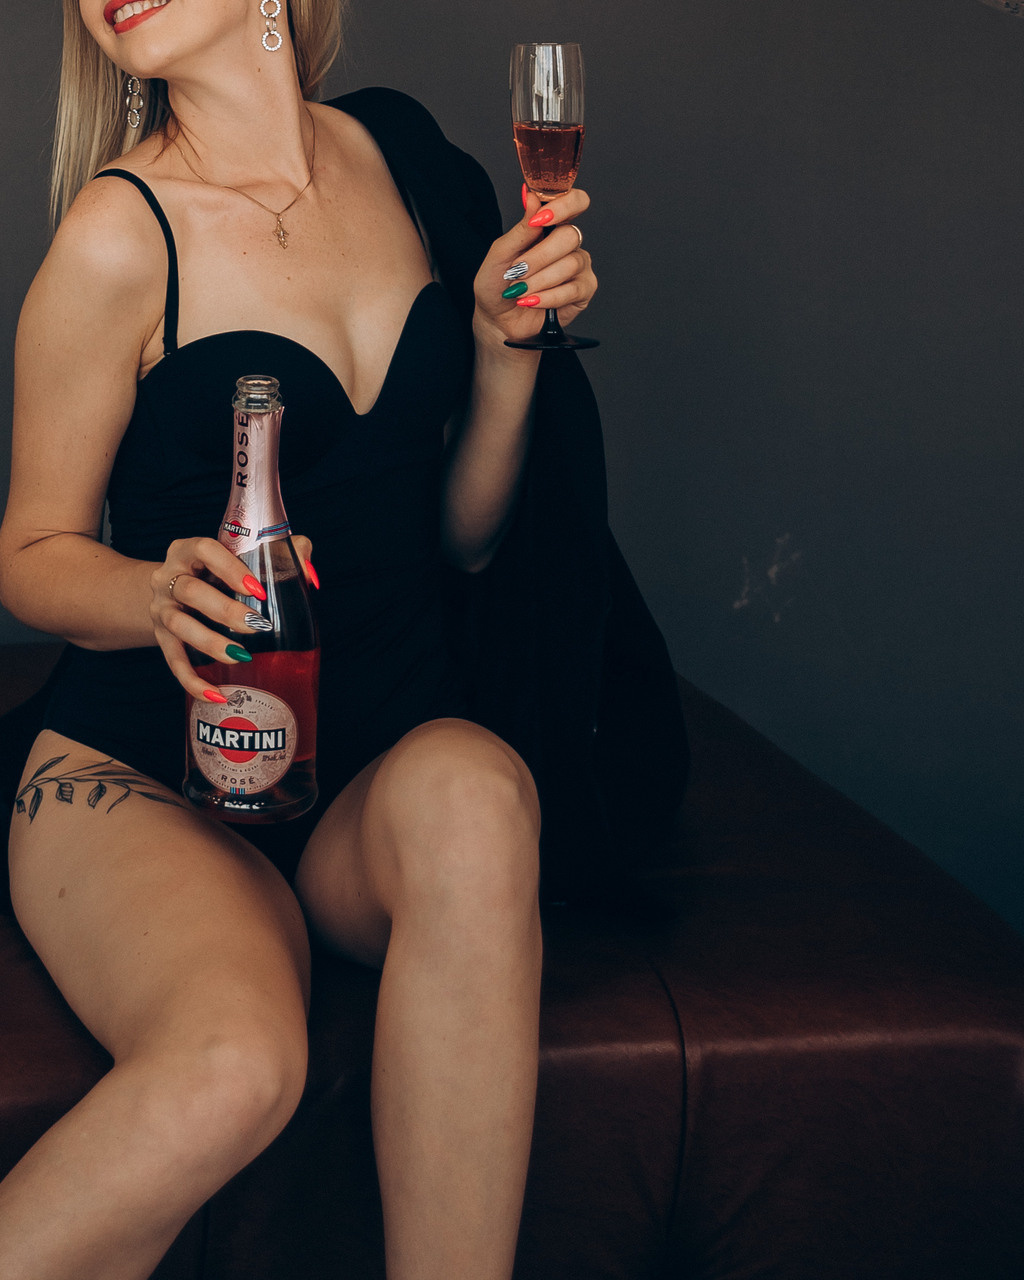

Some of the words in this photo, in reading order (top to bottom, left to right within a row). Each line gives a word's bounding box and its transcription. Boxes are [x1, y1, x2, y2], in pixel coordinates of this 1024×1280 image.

[223, 522, 251, 536] MARTINI
[199, 722, 283, 750] MARTINI
[220, 774, 256, 786] ROSÉ
